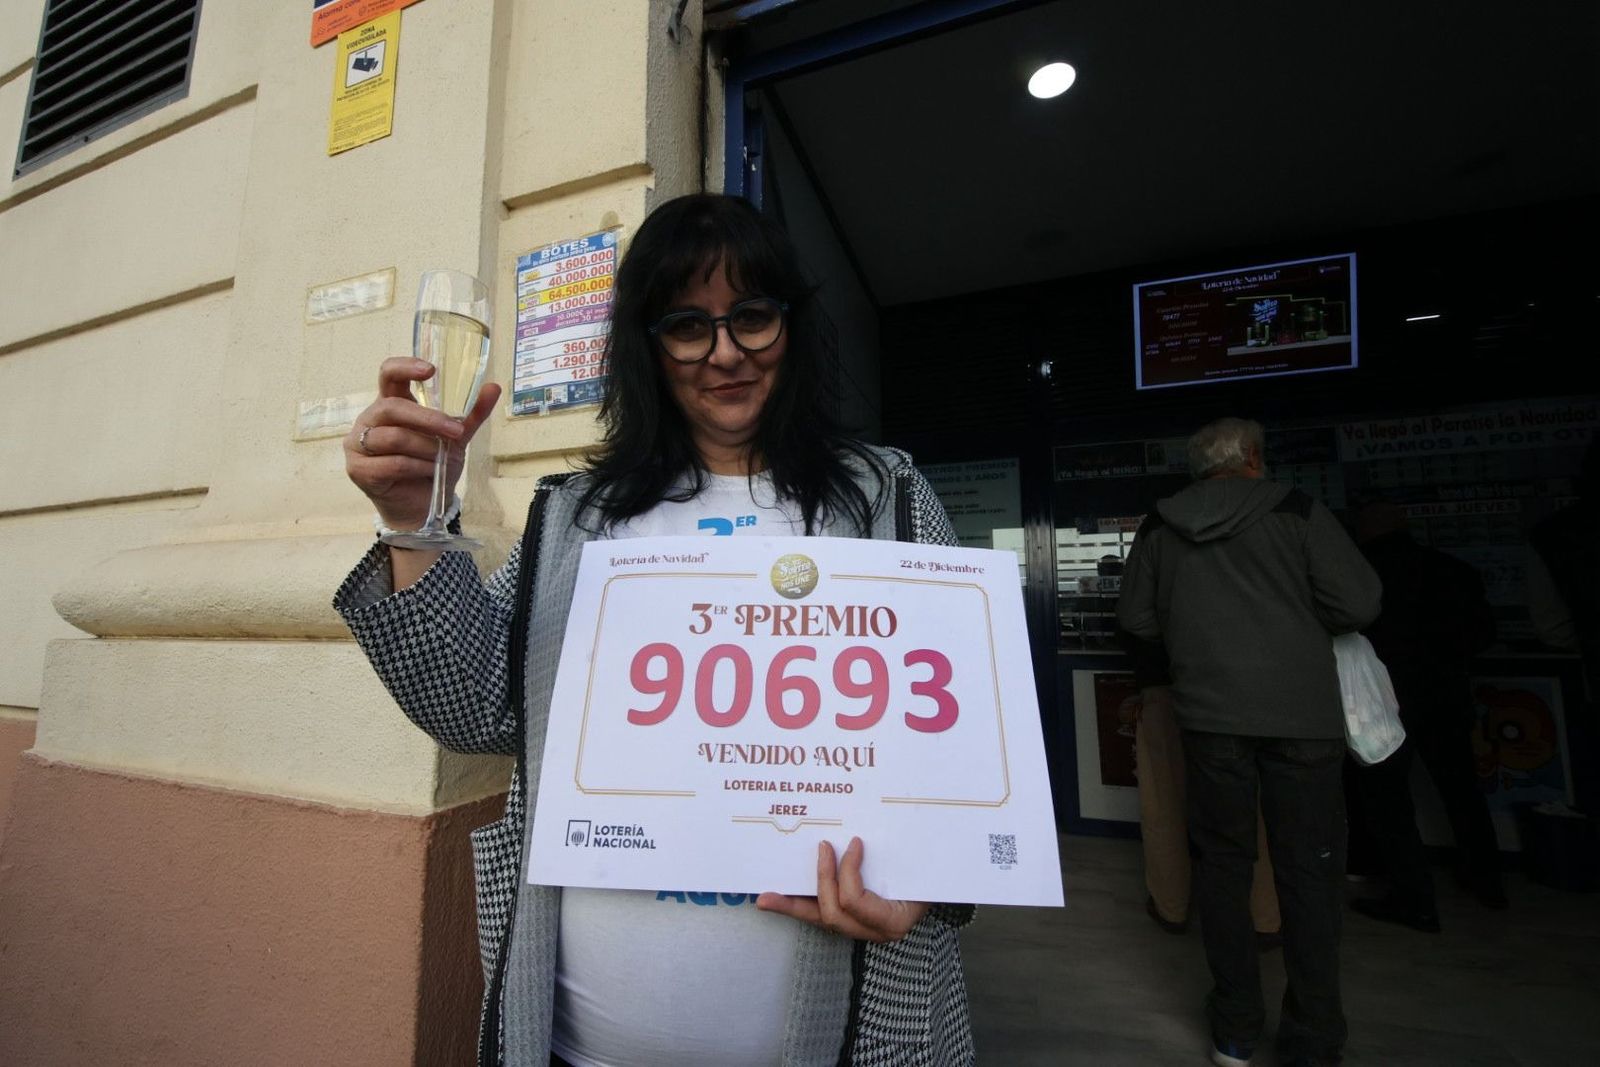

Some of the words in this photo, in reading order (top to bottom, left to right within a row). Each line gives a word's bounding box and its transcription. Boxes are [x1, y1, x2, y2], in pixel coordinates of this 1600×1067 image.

[360, 25, 376, 36] ZONA
[541, 238, 589, 259] BOTES
[556, 250, 613, 272] 3.600.000
[549, 264, 613, 286] 40.000.000
[549, 277, 613, 300] 64.500.000
[549, 291, 613, 313] 13.000.000
[1343, 424, 1365, 440] Ya
[1463, 435, 1479, 447] A
[1489, 431, 1543, 446] POR
[648, 554, 660, 564] de
[662, 552, 710, 564] Navidad
[900, 560, 912, 569] 22
[914, 561, 926, 570] de
[928, 561, 985, 574] Diciembre
[734, 603, 898, 639] PREMIO
[627, 642, 960, 734] 90693
[698, 743, 806, 767] VENDIDO
[813, 741, 876, 772] AQUÍ
[724, 779, 777, 793] LOTERIA
[779, 781, 794, 793] EL
[796, 781, 854, 795] PARAISO
[768, 803, 808, 817] JEREZ
[594, 824, 645, 837] LOTERÍA
[593, 837, 657, 850] NACIONAL
